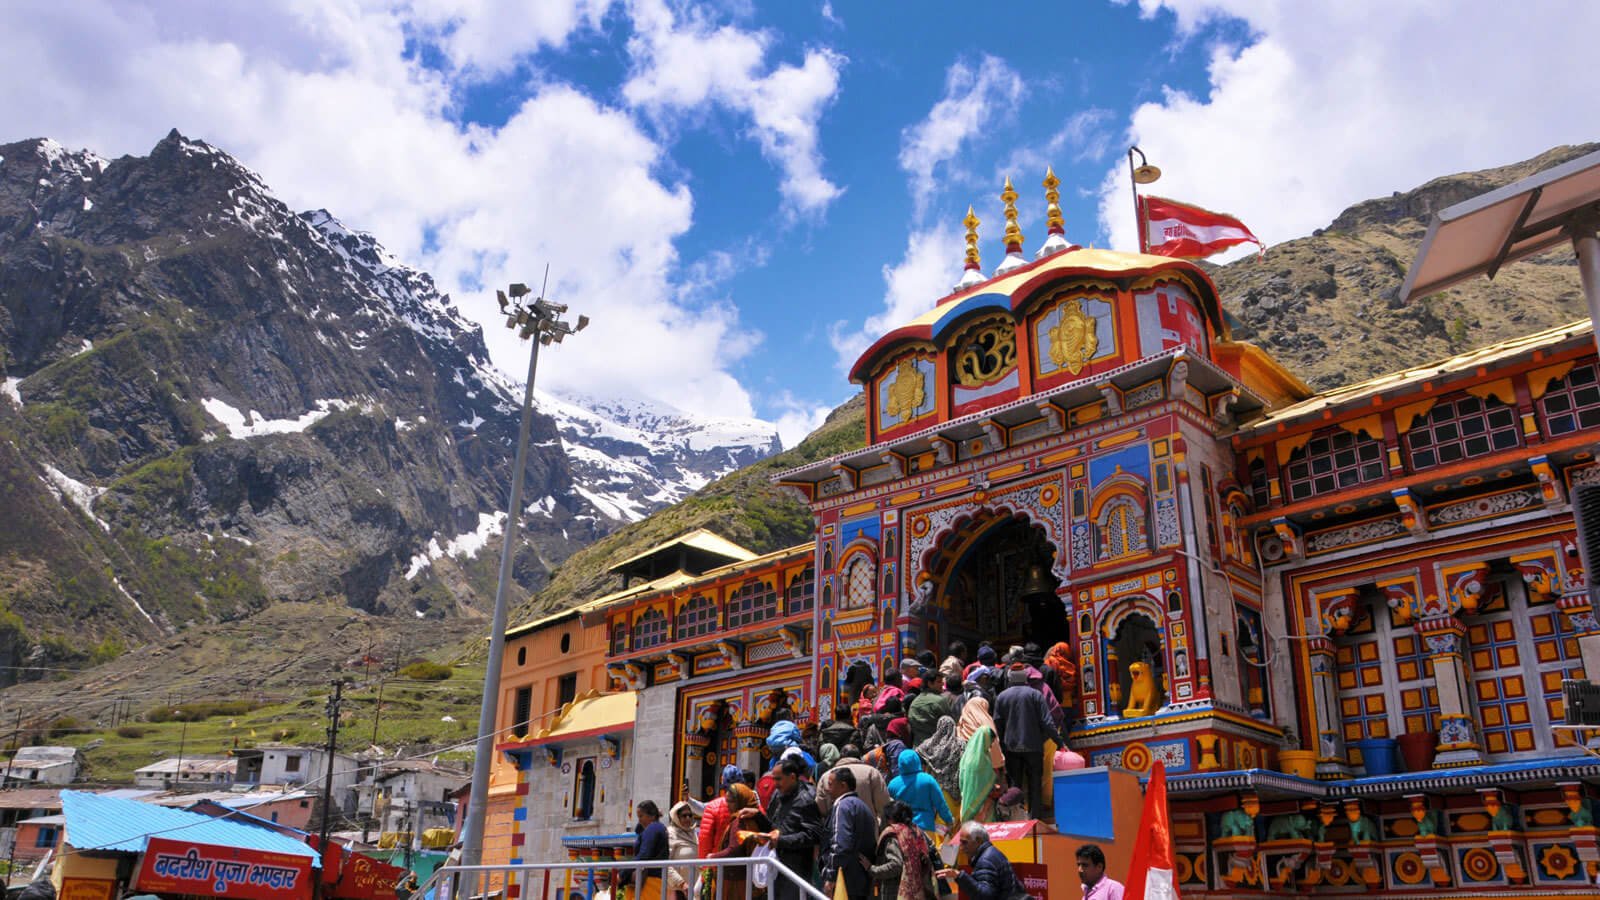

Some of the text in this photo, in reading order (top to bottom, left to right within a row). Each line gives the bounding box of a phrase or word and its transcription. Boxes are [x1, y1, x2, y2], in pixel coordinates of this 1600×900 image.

[155, 849, 300, 892] बदरीश पूजा भण्डार
